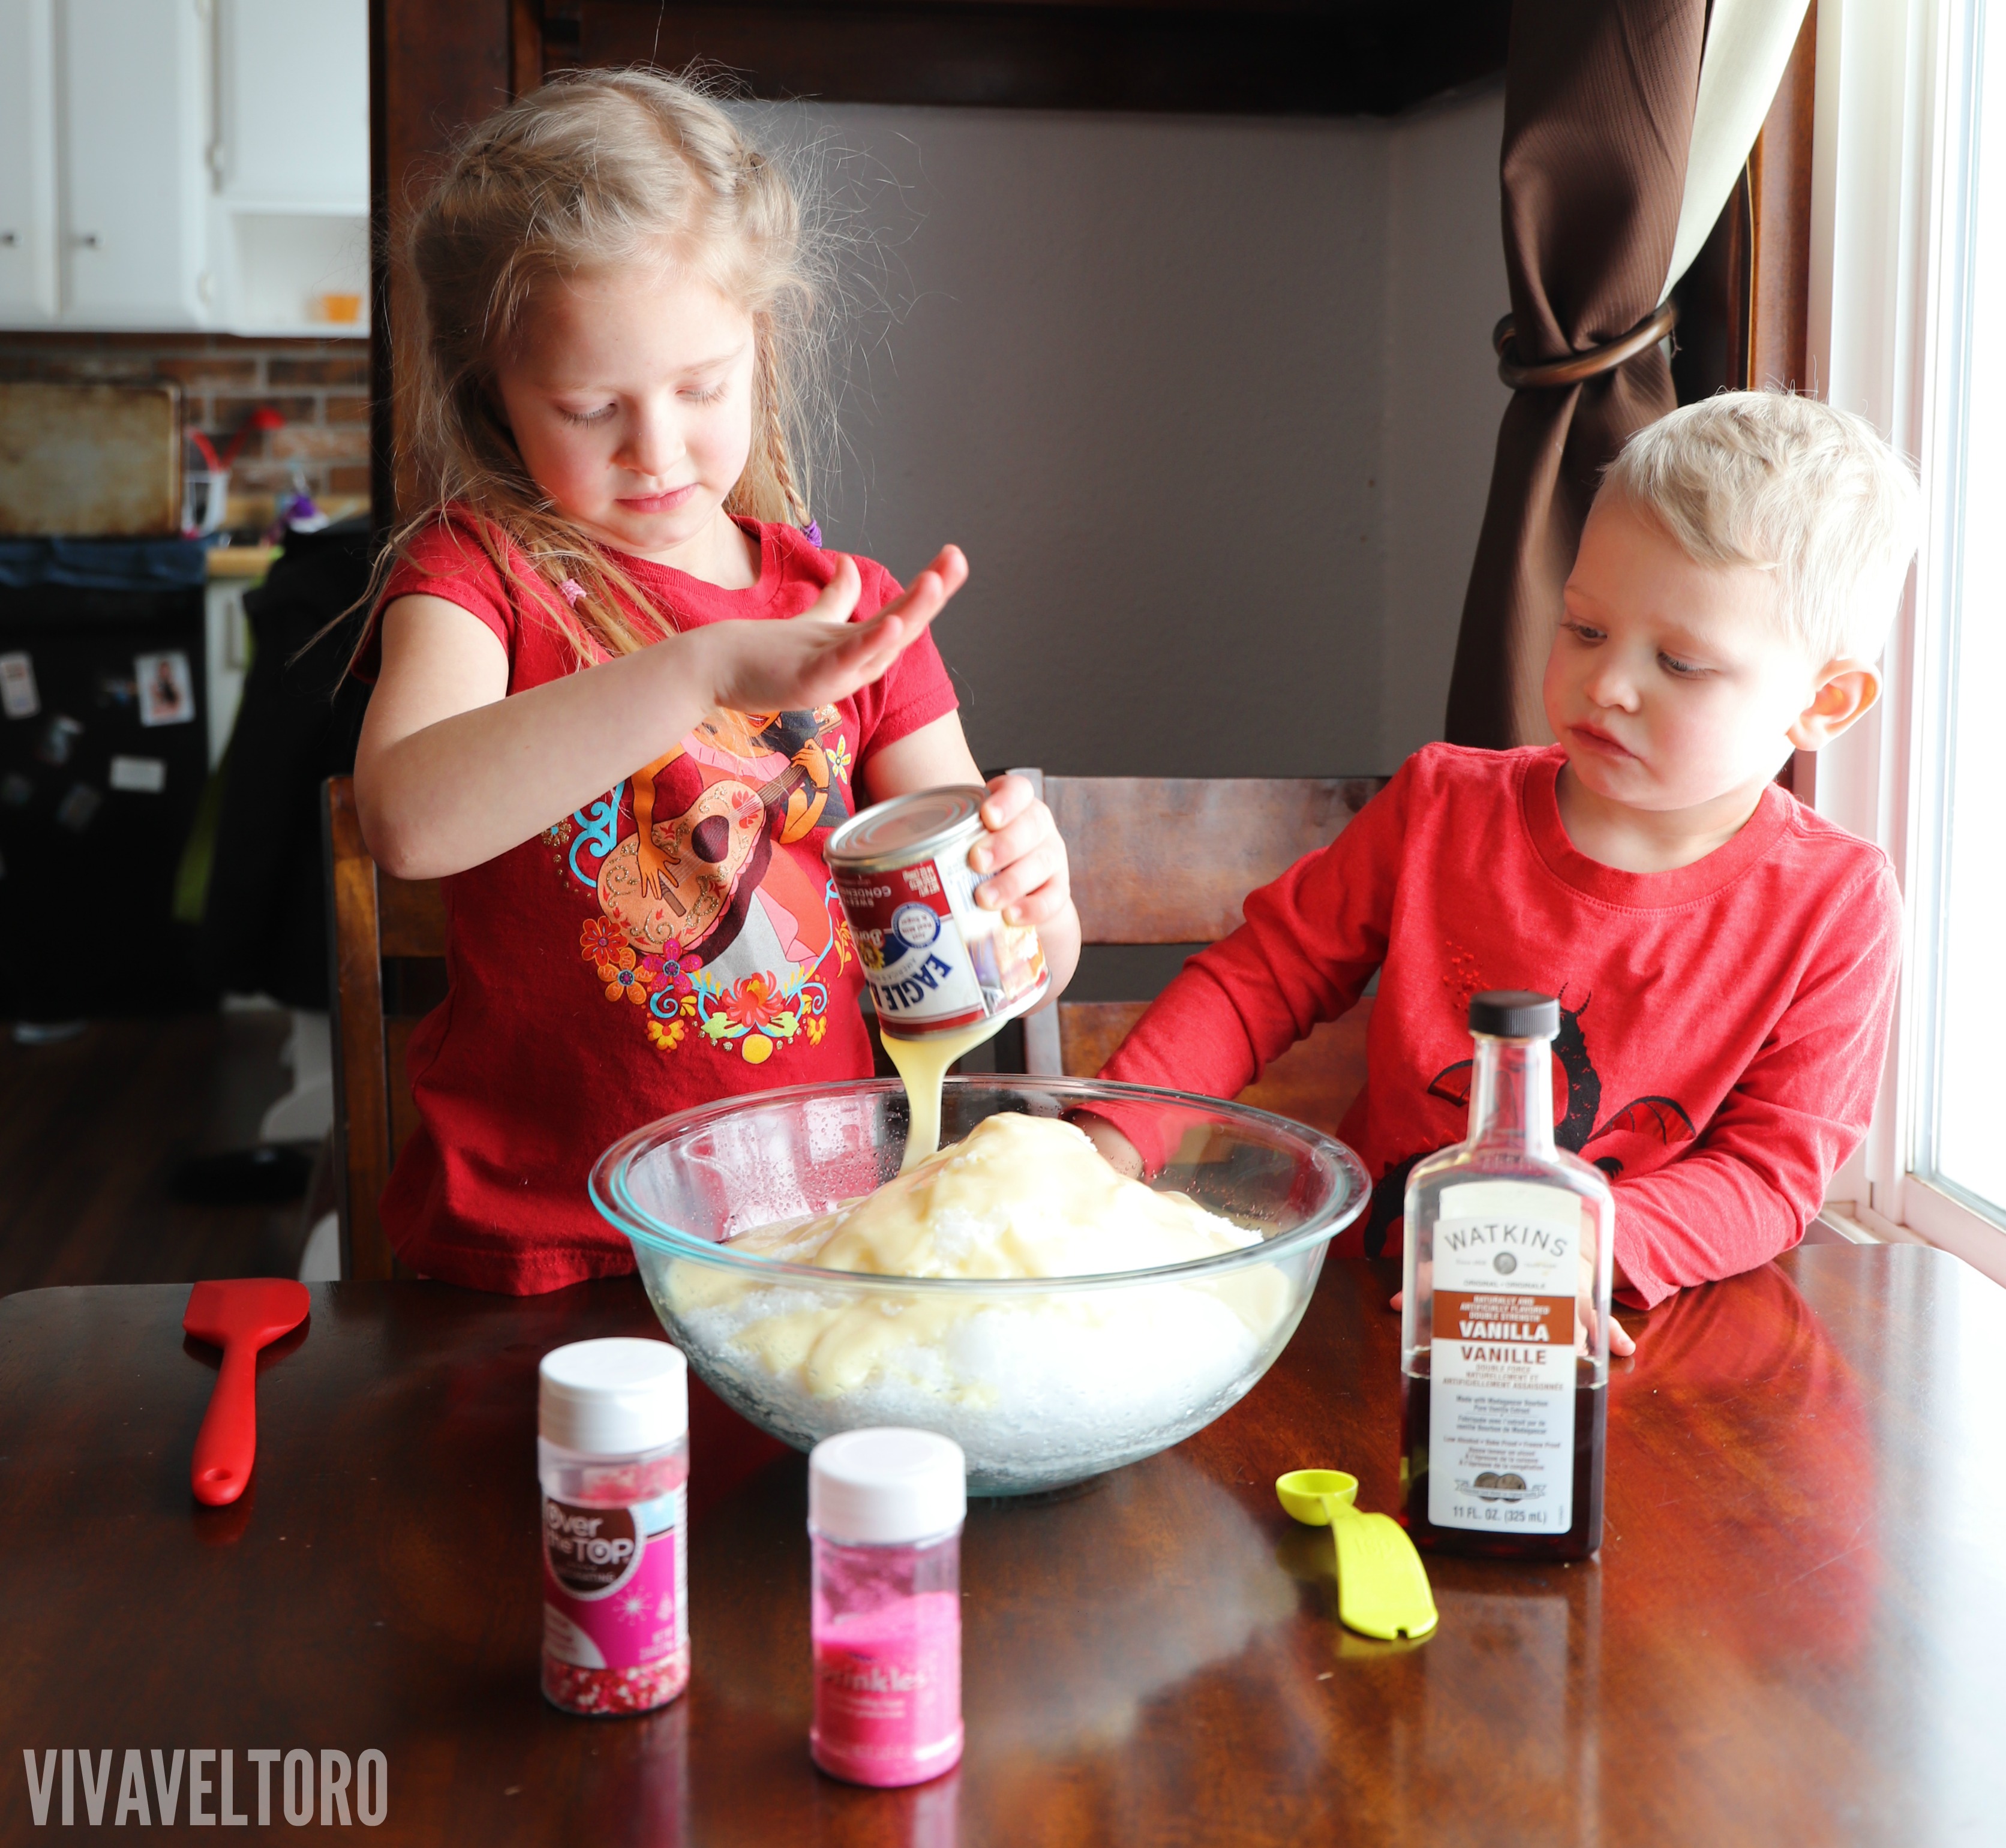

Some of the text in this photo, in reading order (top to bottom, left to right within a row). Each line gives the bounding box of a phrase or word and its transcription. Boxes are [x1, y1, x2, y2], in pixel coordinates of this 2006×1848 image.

[882, 952, 953, 1010] EAGLE
[1444, 1224, 1569, 1258] WATKINS
[1469, 1312, 1499, 1320] DOUBLE
[1459, 1320, 1549, 1342] VANILLA
[1461, 1347, 1546, 1365] VANILLE
[1453, 1506, 1463, 1518] 11
[1467, 1507, 1481, 1519] FL.
[1485, 1509, 1500, 1521] OZ.
[1504, 1510, 1525, 1524] (325
[572, 1537, 635, 1564] TOP
